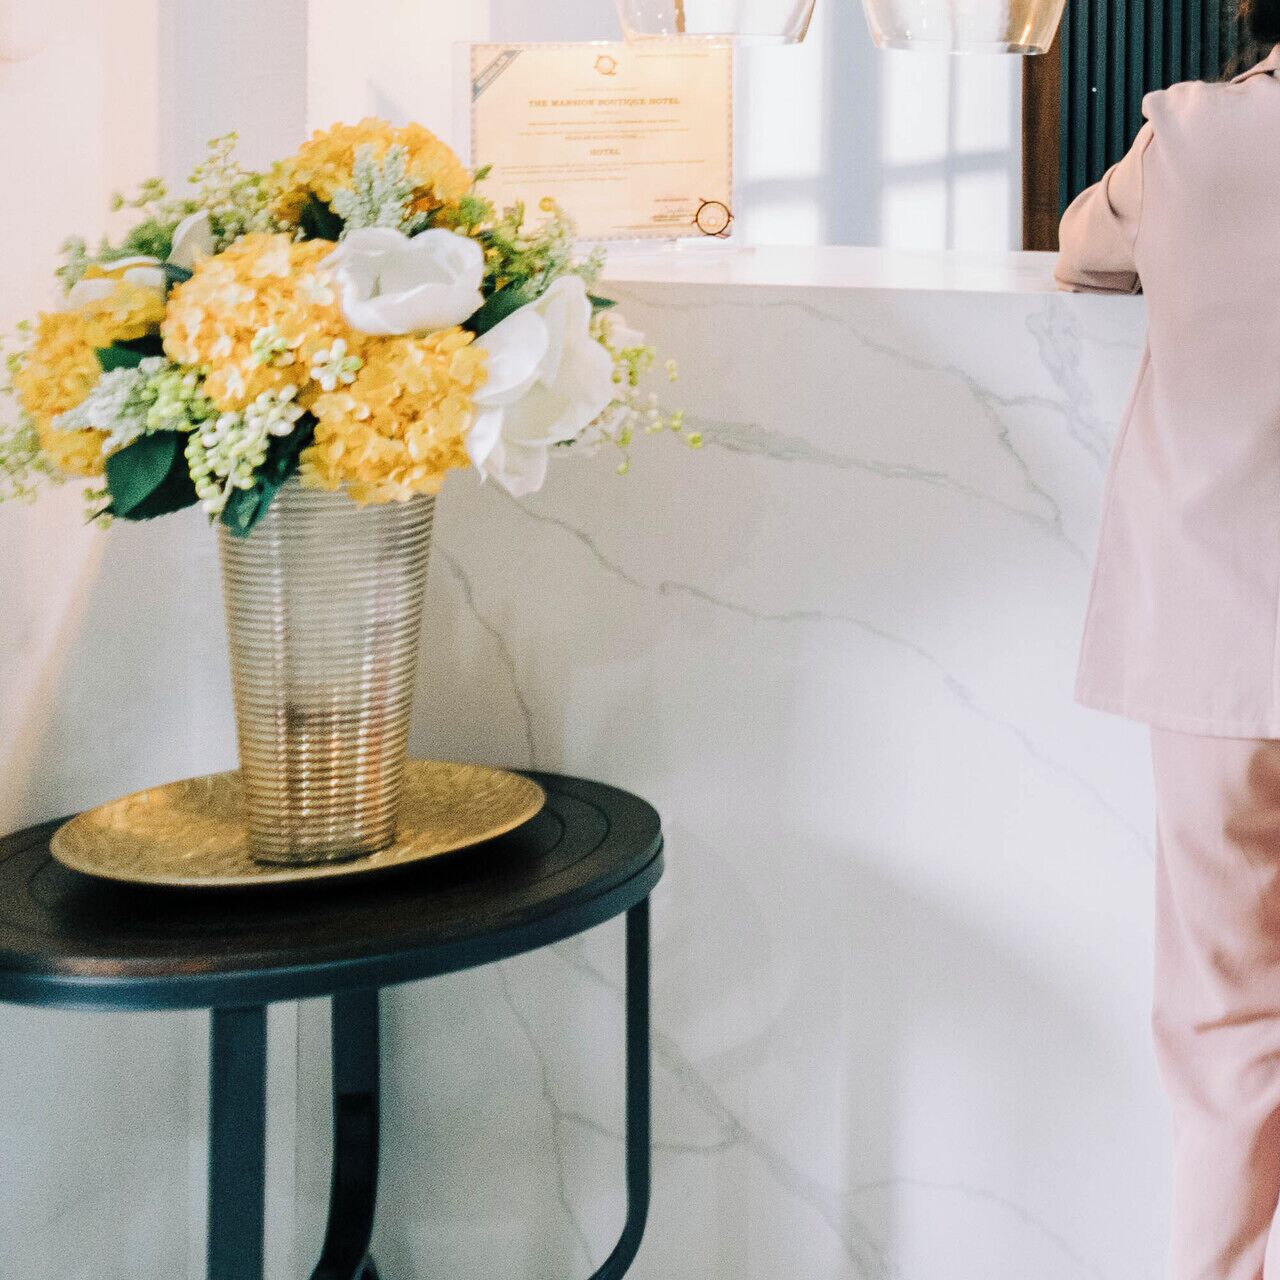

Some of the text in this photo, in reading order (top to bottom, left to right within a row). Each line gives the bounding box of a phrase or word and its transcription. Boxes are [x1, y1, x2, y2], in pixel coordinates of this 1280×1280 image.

[528, 96, 680, 108] THE MANSION BOUTIQUE HOTEL
[589, 148, 621, 157] HOTEL
